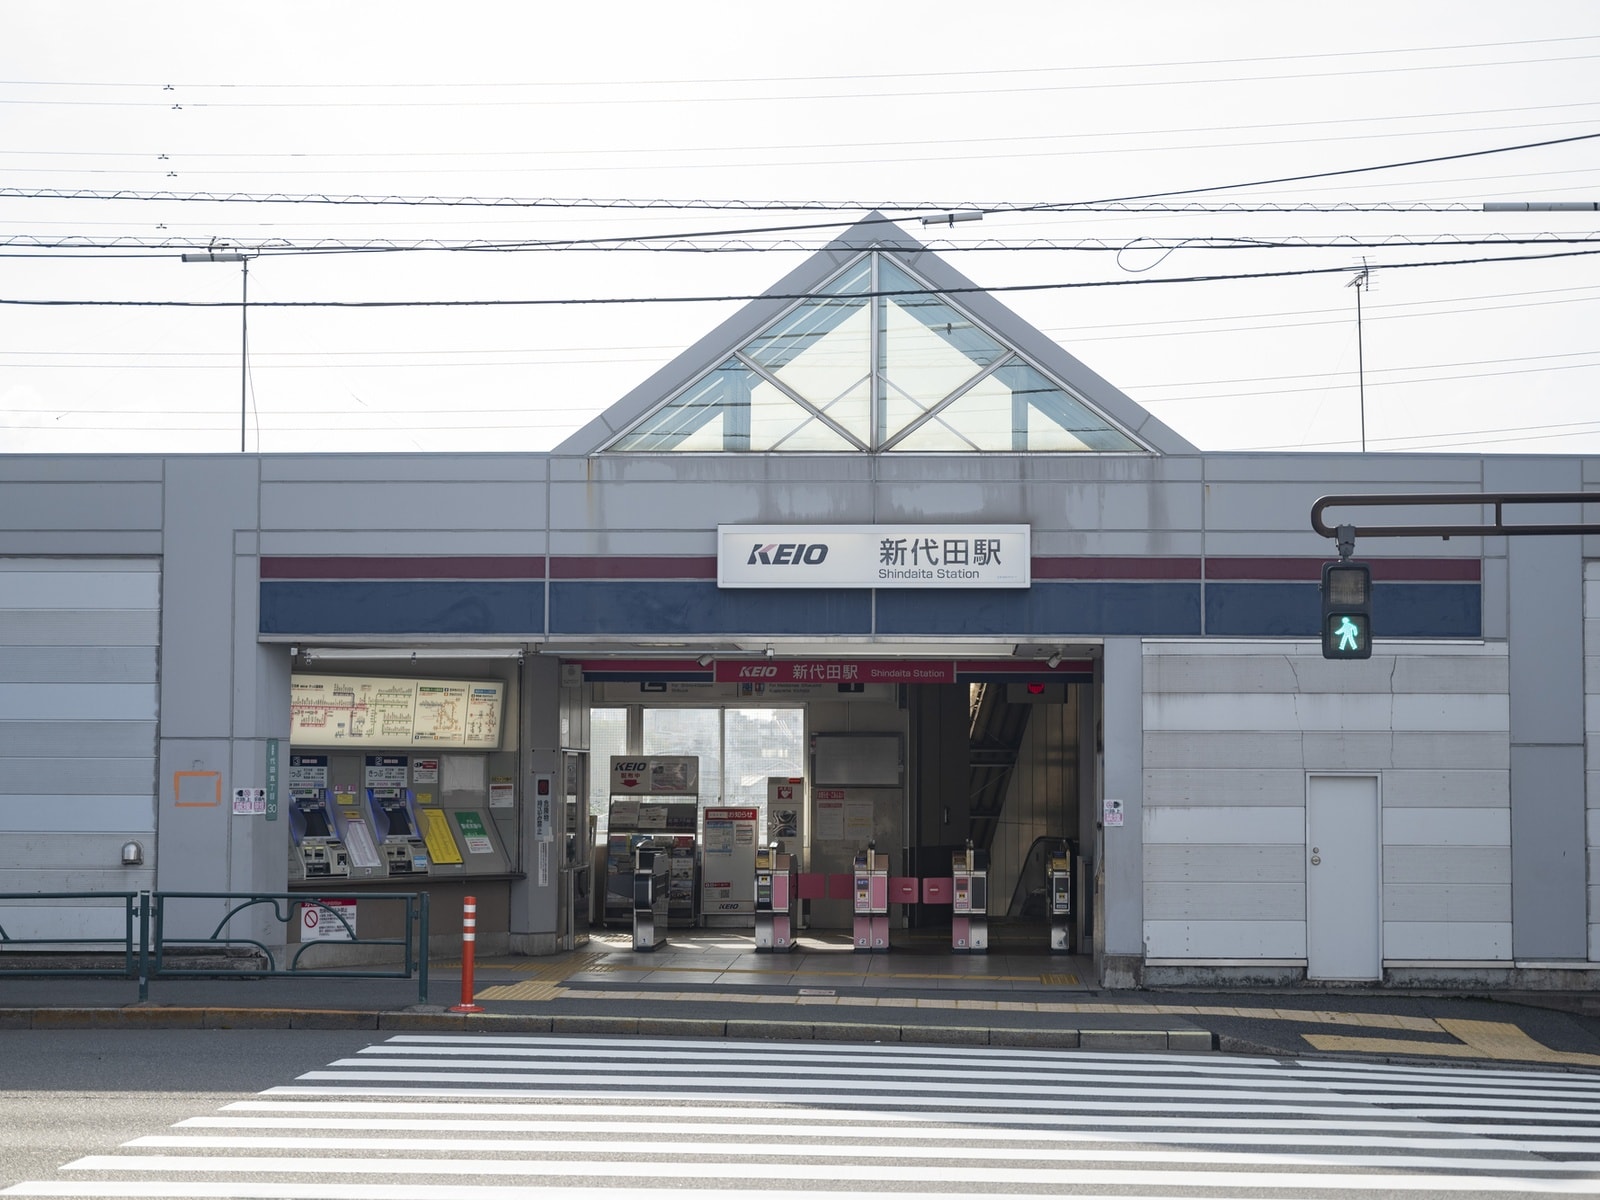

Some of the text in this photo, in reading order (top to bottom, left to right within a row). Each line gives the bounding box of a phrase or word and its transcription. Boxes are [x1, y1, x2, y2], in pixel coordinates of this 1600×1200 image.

[746, 543, 829, 565] KEIO
[879, 538, 1002, 566] 新代田駅
[878, 568, 980, 579] Shindaita Station
[739, 666, 777, 677] KEIO
[792, 664, 858, 680] 新代田駅
[871, 668, 945, 678] Shindaita Station
[614, 762, 647, 771] KEIO
[267, 803, 277, 813] 30
